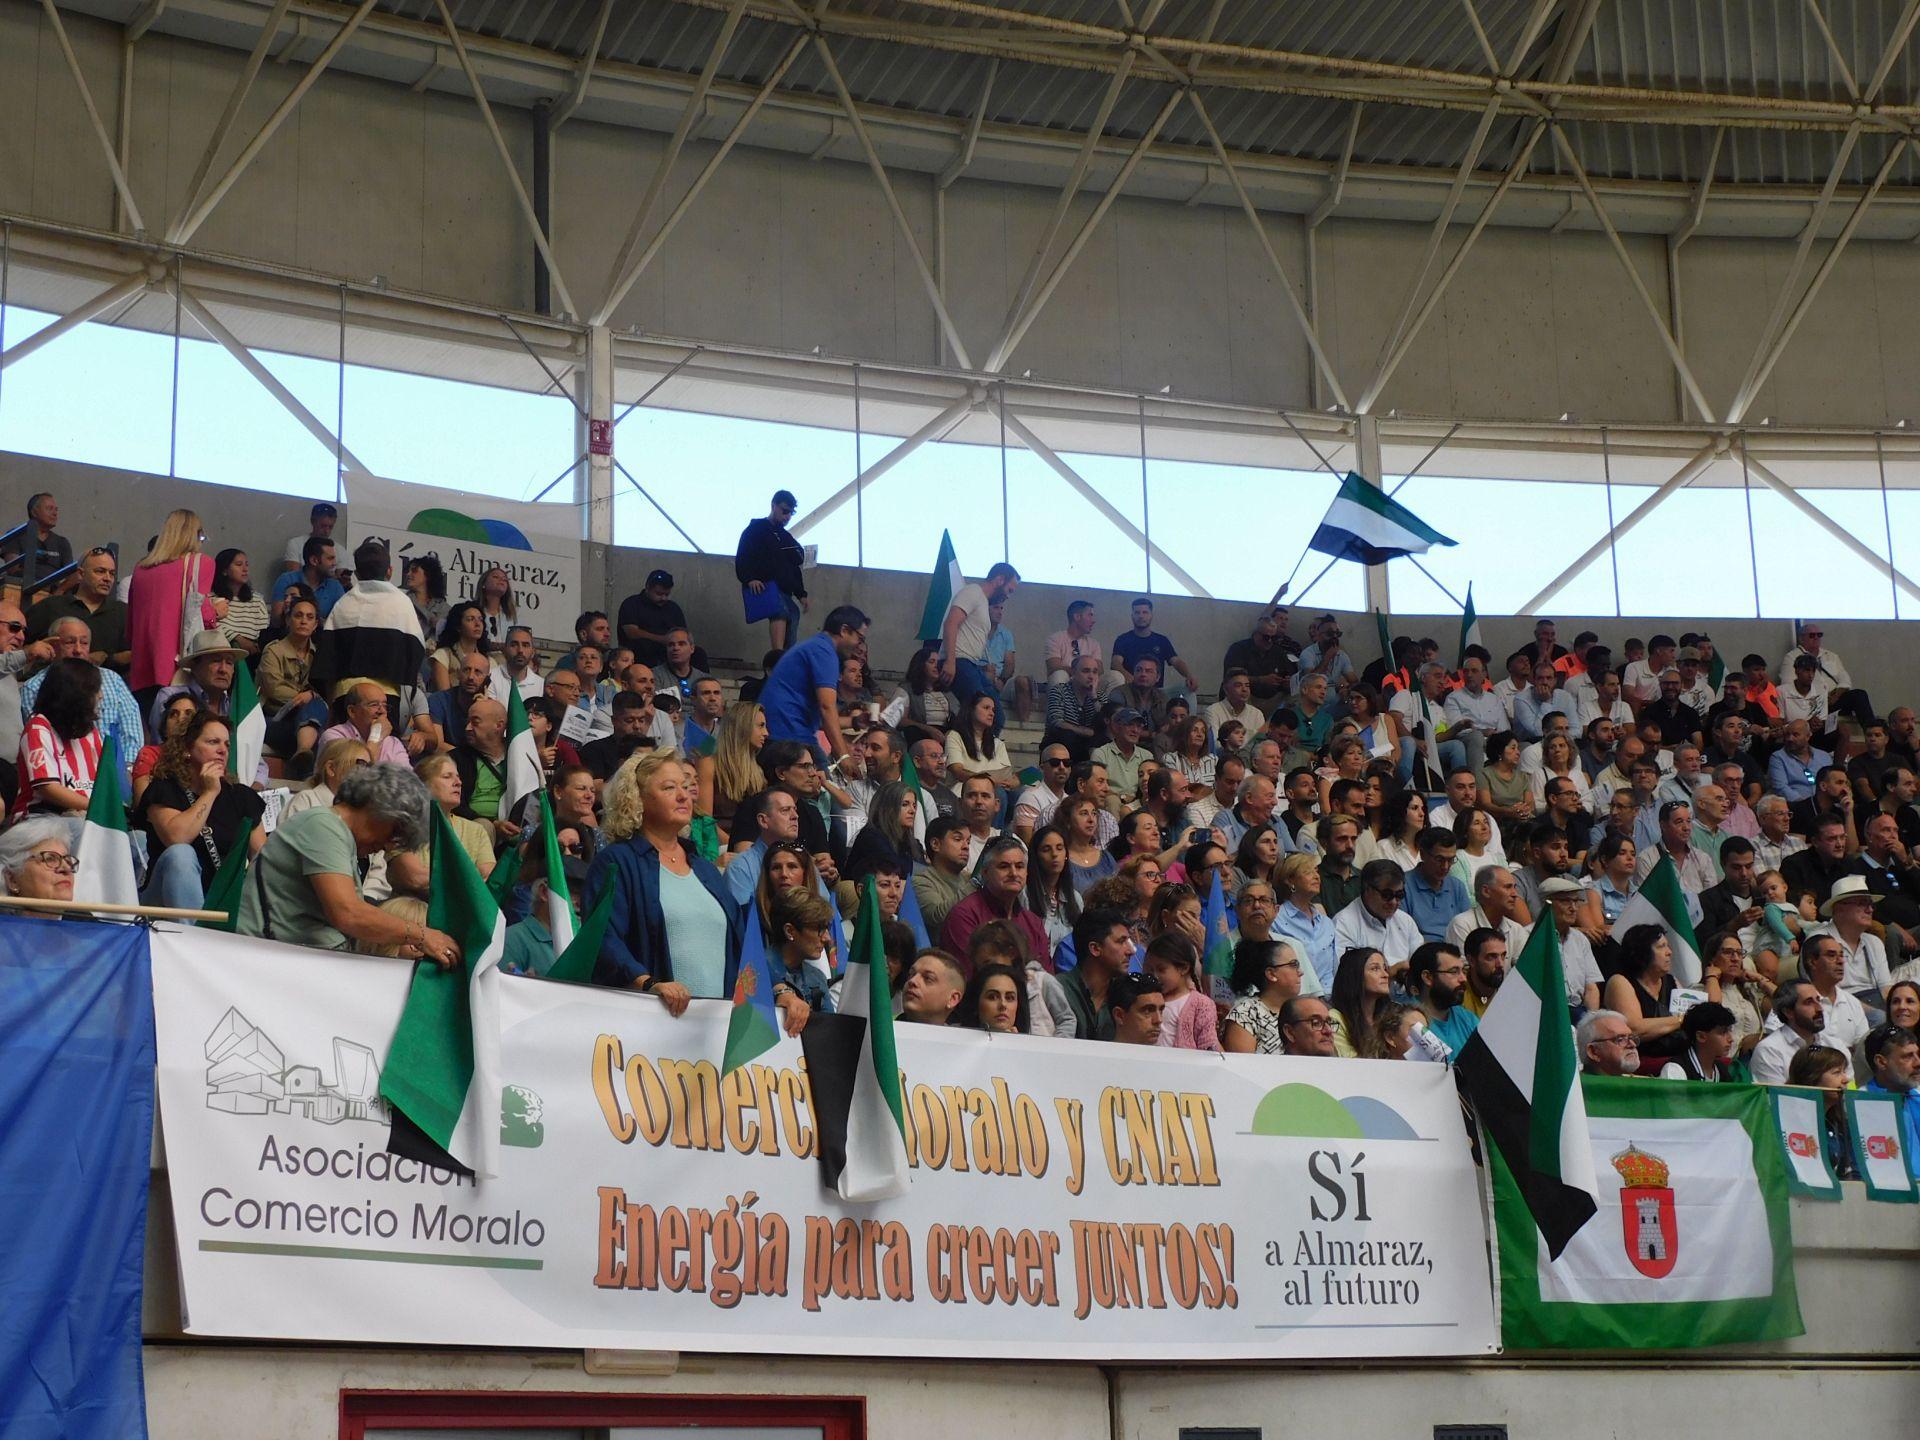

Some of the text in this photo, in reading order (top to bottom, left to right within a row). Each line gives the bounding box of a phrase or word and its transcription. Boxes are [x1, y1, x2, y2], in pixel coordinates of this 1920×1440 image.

[449, 548, 566, 594] Almaraz,
[592, 1033, 1221, 1195] Comerci oralo y CNAT
[200, 1186, 545, 1247] Comercio Moralo
[1308, 1150, 1373, 1224] Sí
[593, 1186, 1238, 1320] Energía para crecer JUNTOS!
[1265, 1231, 1434, 1273] a Almaraz,
[1284, 1269, 1420, 1307] al futuro
